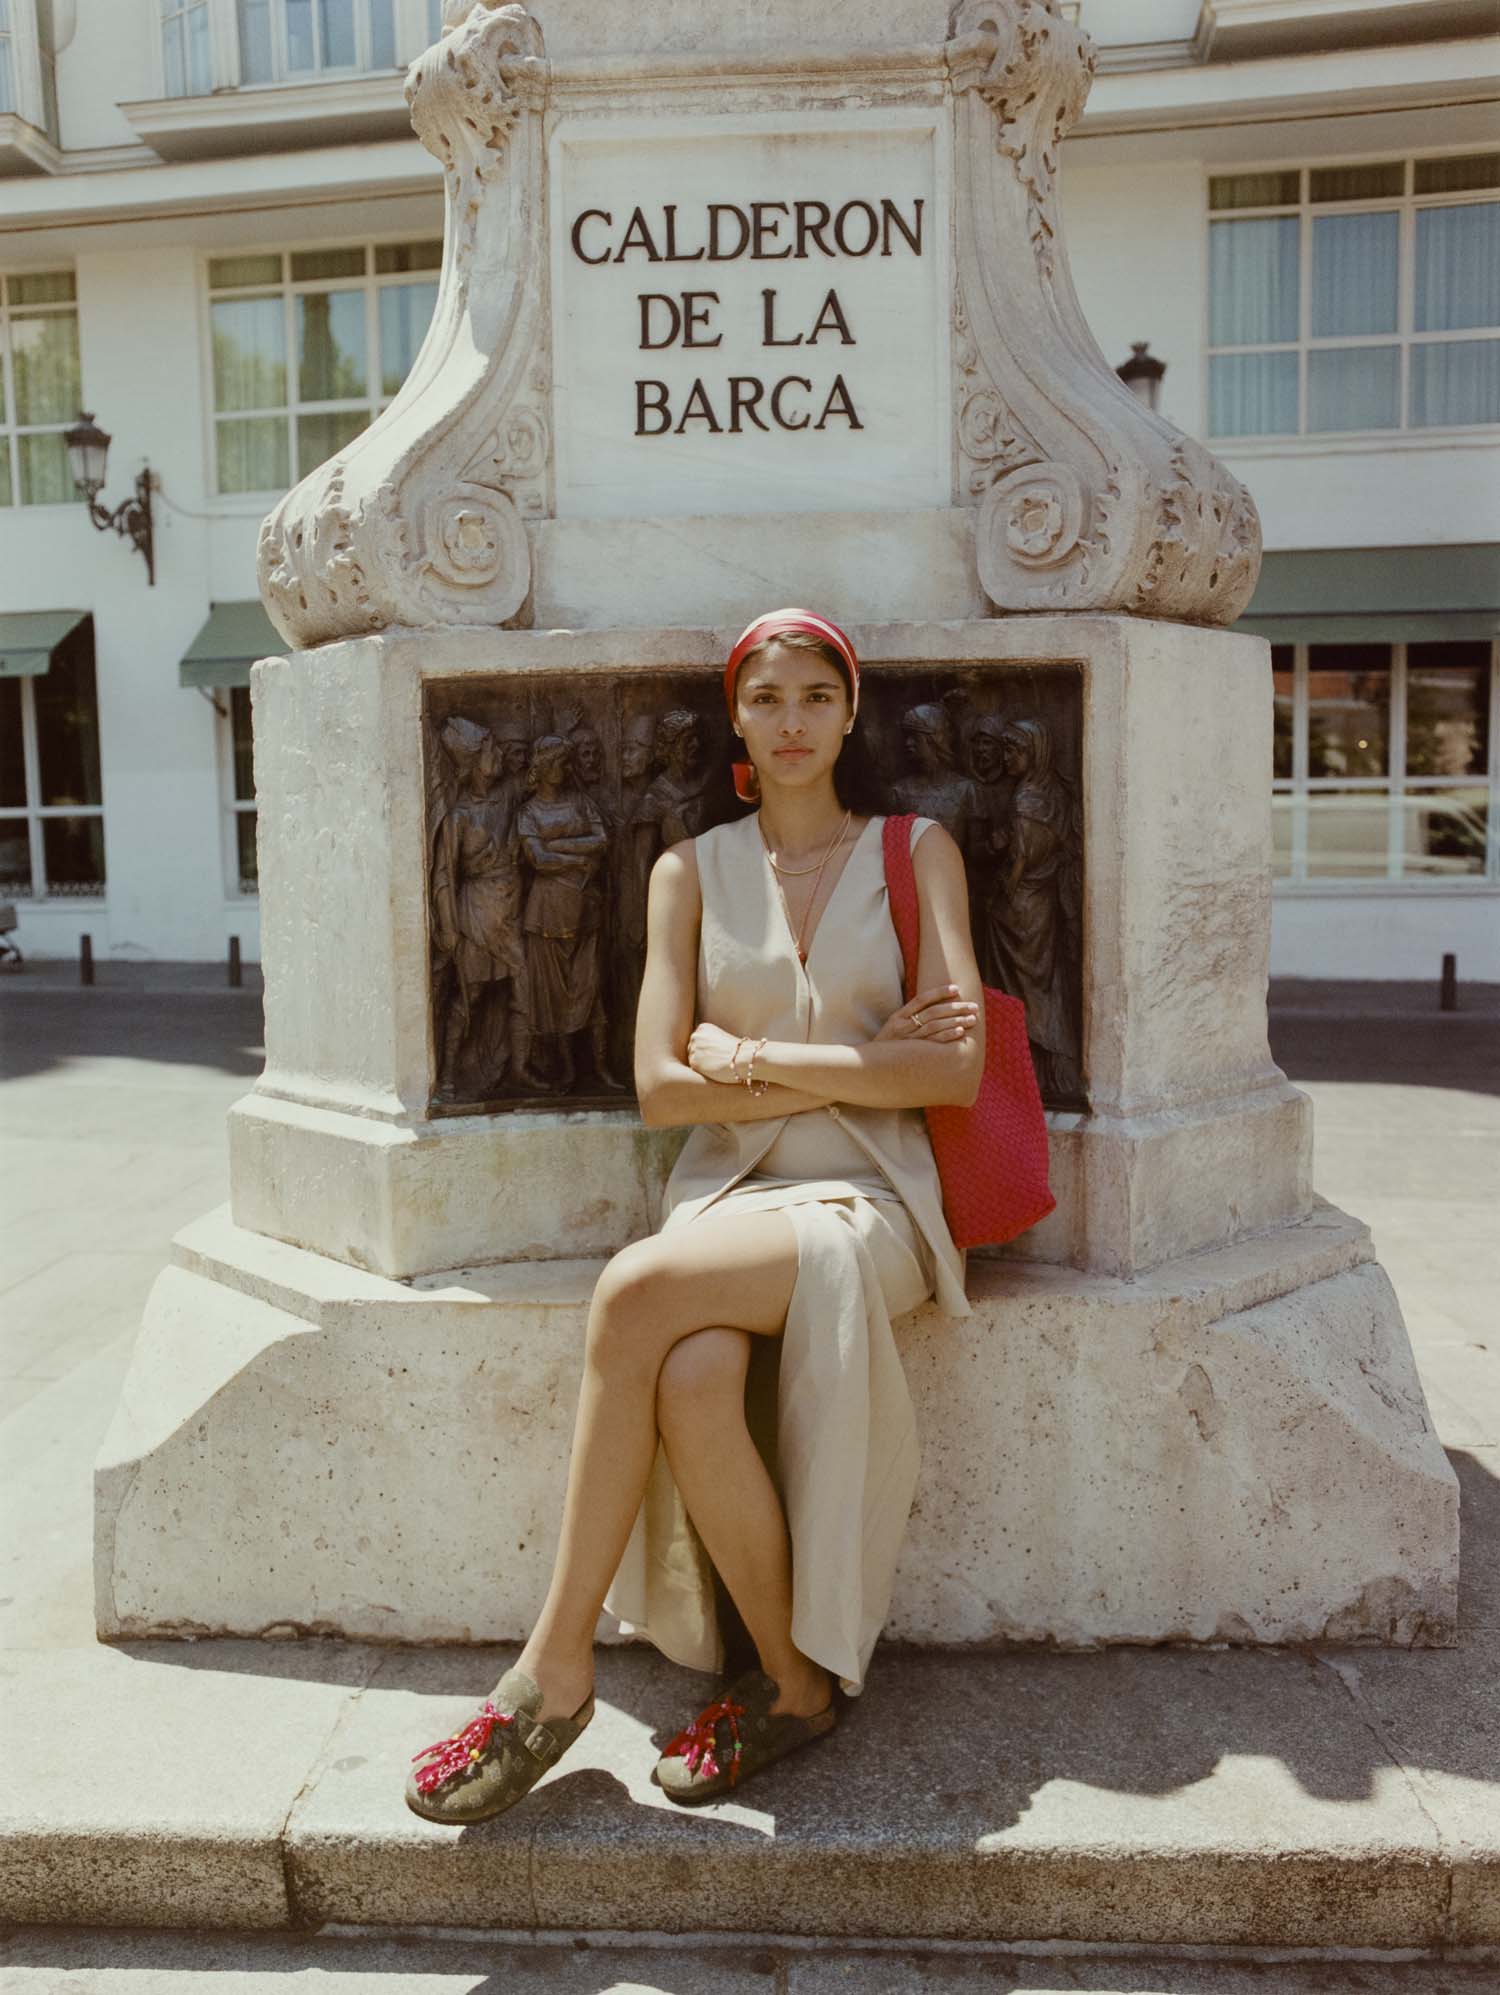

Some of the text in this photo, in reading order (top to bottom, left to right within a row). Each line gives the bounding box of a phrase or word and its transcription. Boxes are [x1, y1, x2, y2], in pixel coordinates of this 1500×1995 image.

[571, 199, 924, 264] CALDERON
[638, 288, 856, 349] DE LA
[634, 374, 864, 435] BARCA
